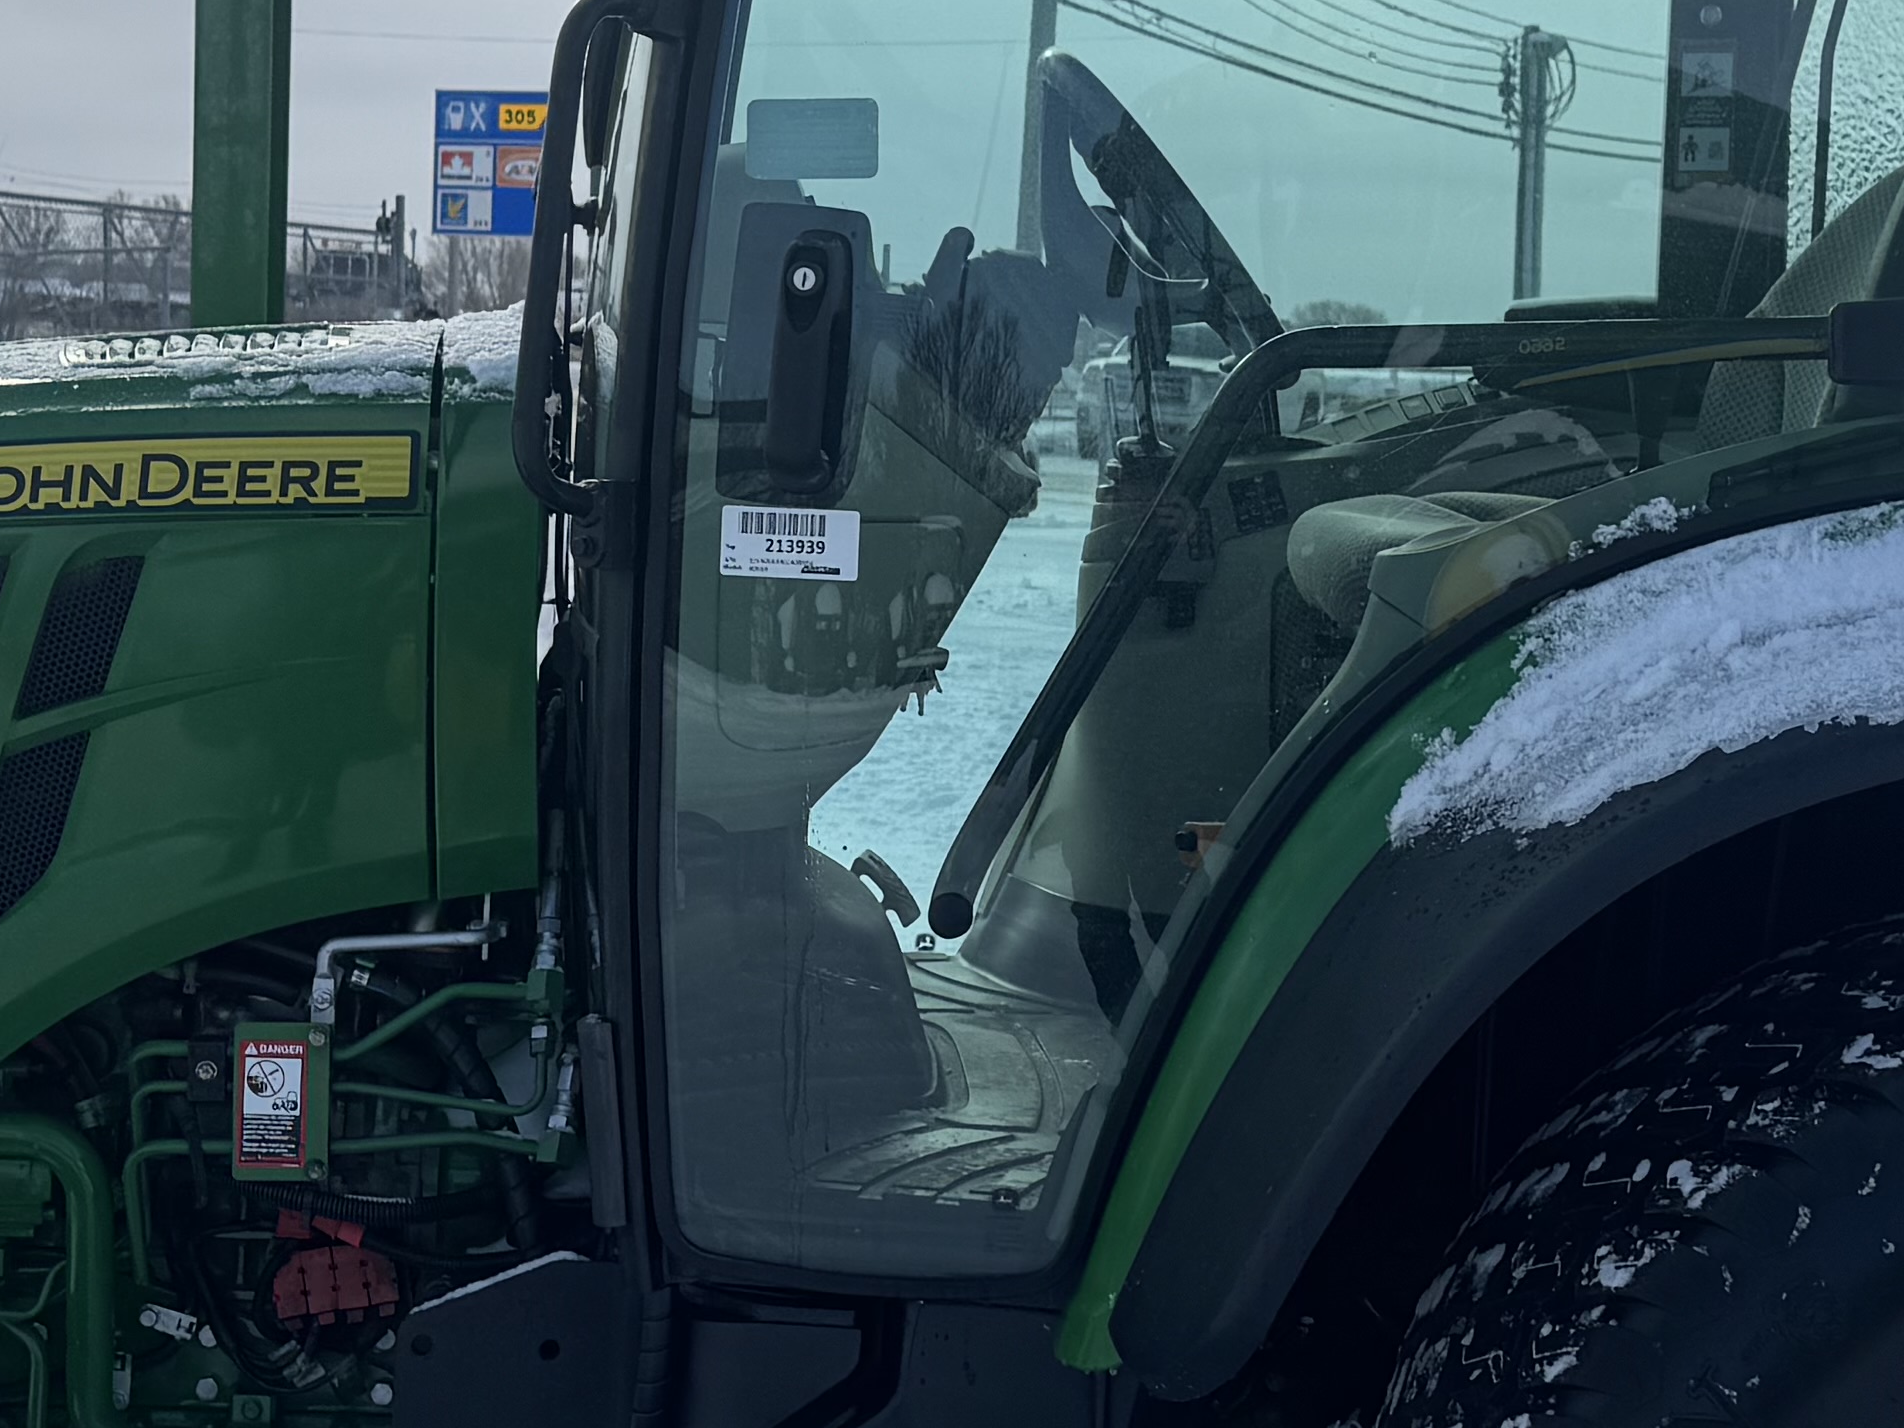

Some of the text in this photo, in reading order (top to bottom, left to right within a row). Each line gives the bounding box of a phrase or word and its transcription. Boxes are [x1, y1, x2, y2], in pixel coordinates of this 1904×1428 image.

[504, 109, 536, 124] 305
[139, 453, 364, 502] DEERE
[765, 538, 826, 555] 213939
[259, 1043, 303, 1055] DANGER
